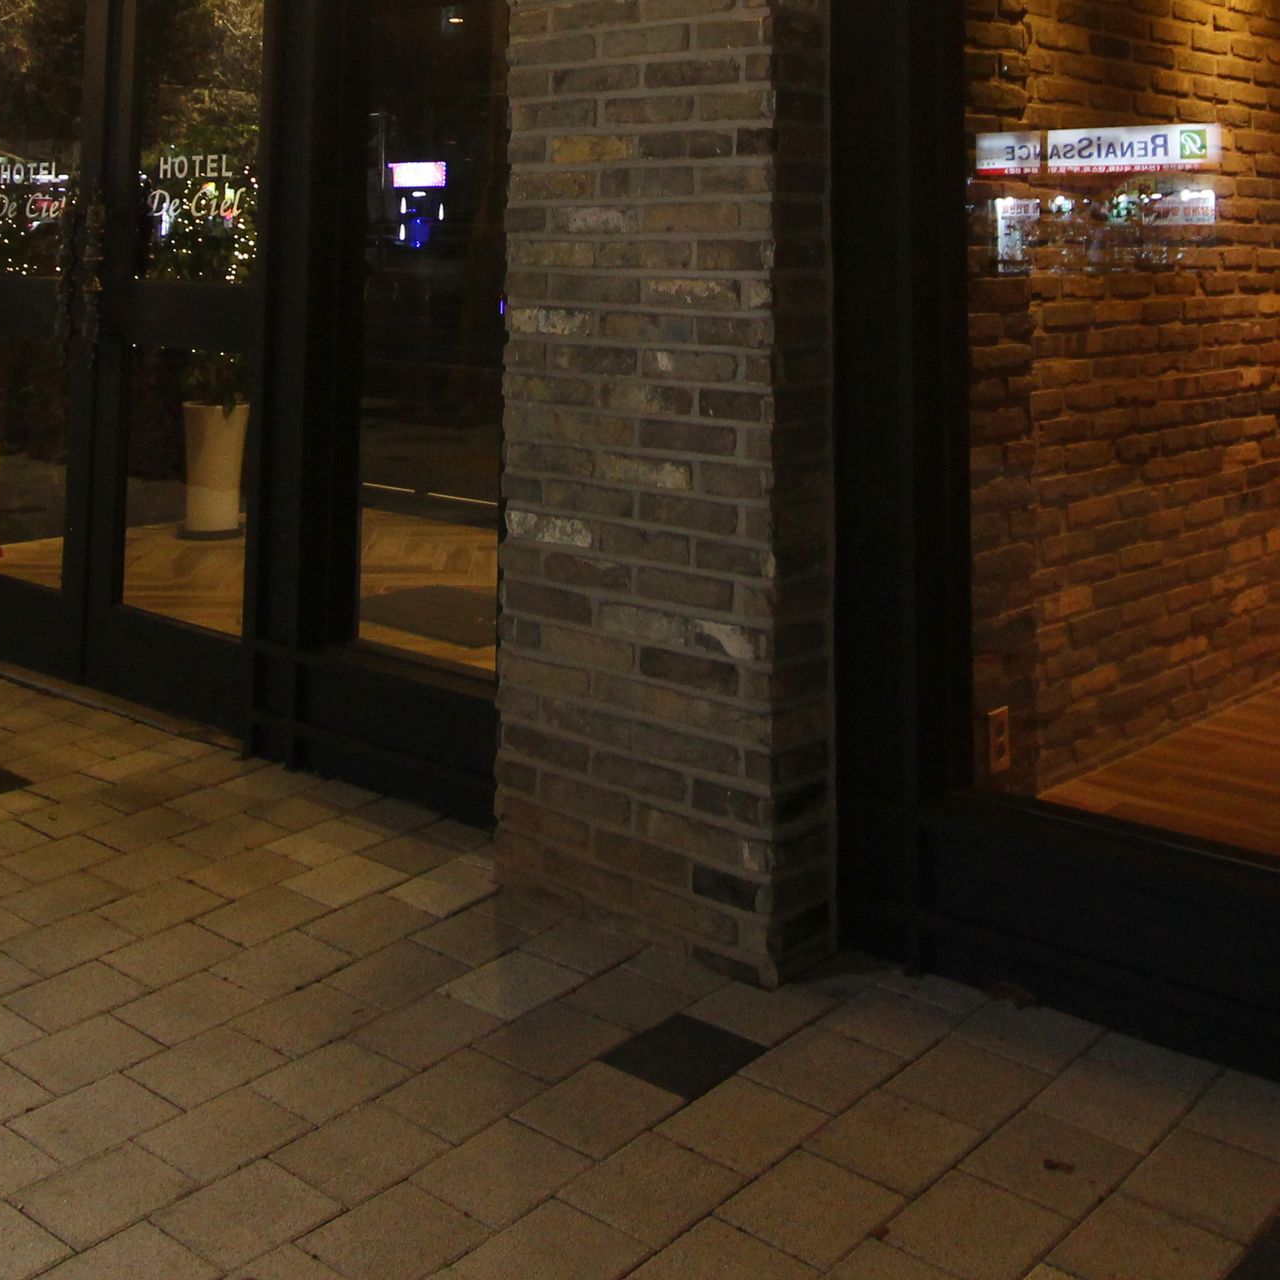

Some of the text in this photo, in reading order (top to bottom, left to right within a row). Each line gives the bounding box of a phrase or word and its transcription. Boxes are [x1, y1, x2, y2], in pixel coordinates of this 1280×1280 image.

[0, 161, 61, 184] HOTEL
[158, 153, 234, 179] HOTEL
[147, 186, 247, 218] De Ciel
